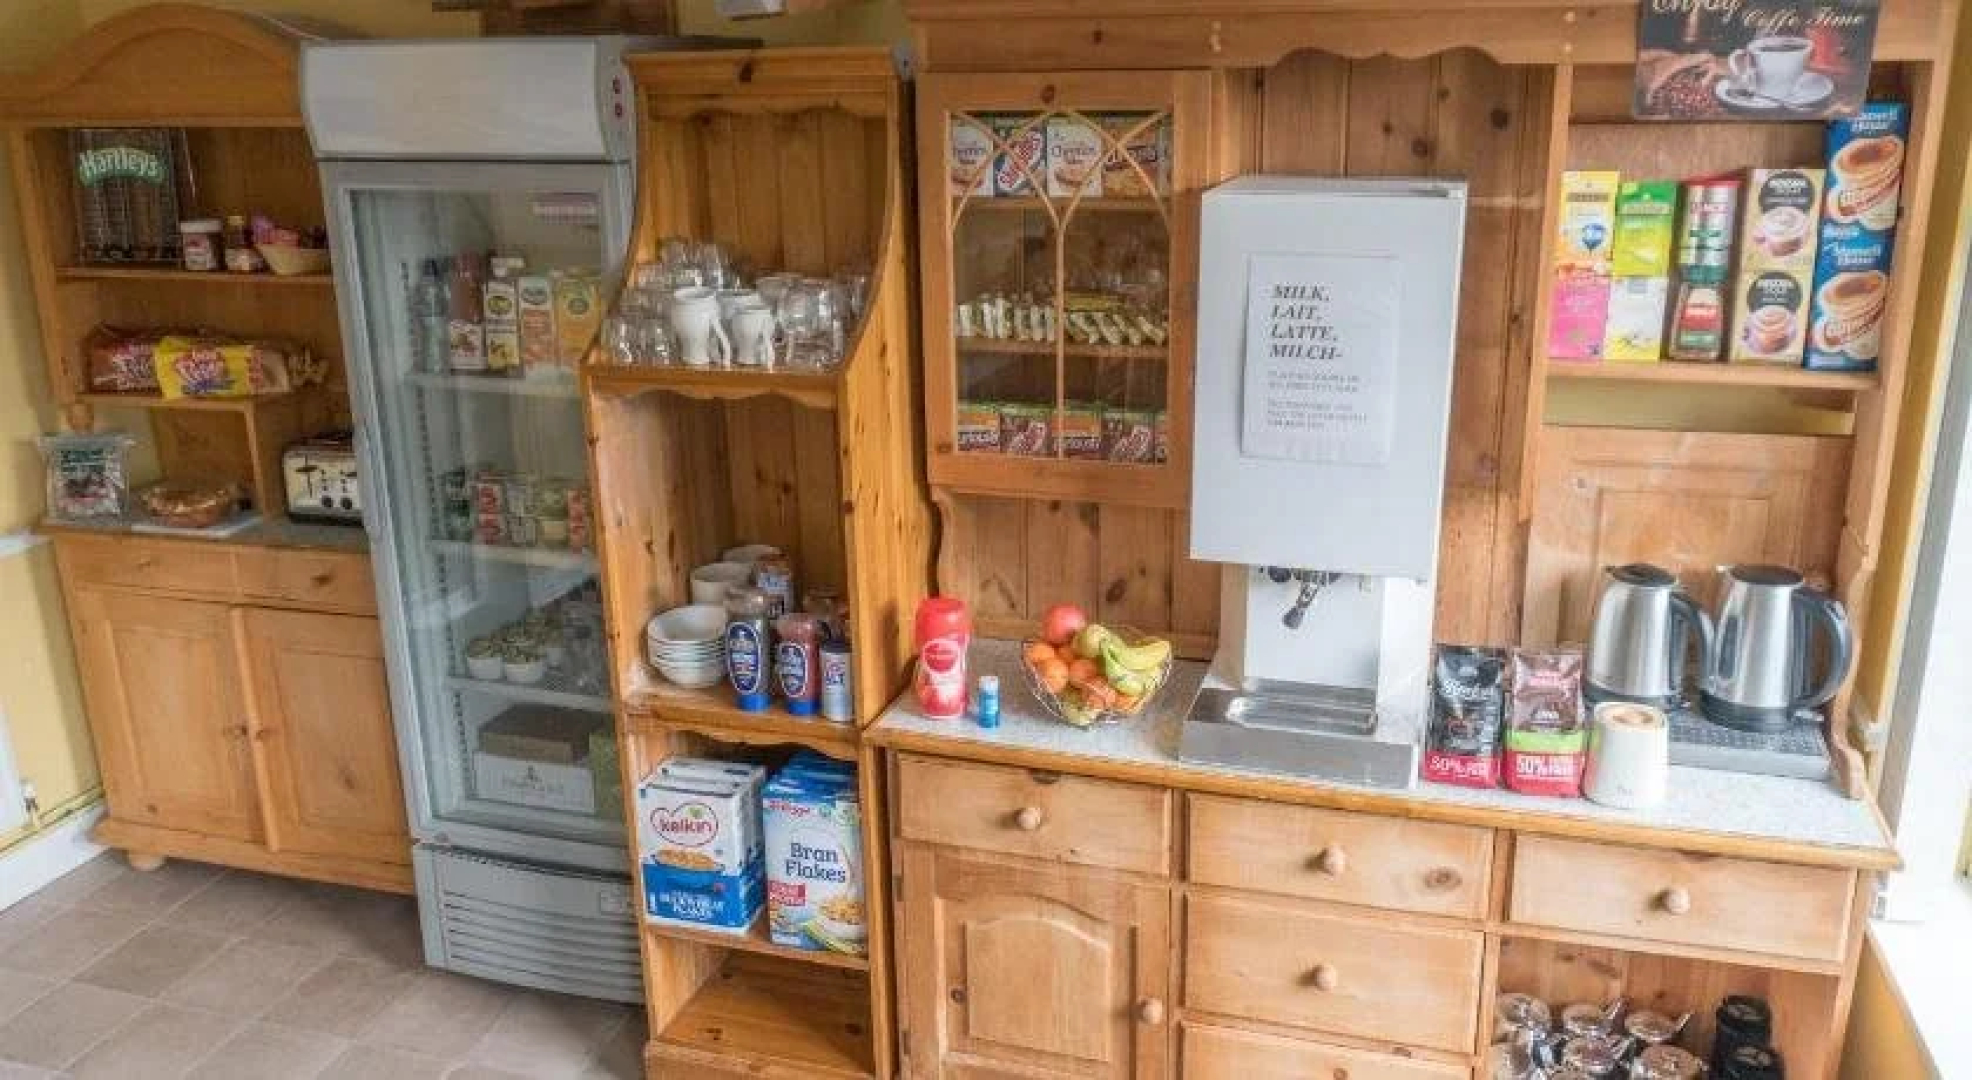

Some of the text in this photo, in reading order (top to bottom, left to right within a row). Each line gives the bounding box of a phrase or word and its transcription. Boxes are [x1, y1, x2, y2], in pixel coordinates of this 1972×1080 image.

[1271, 285, 1330, 301] MILK,
[1271, 304, 1324, 321] LAIT,
[1271, 324, 1338, 342] LATTE,
[1269, 344, 1343, 360] MILCH-
[790, 842, 839, 863] Bran
[785, 859, 847, 884] Flakes
